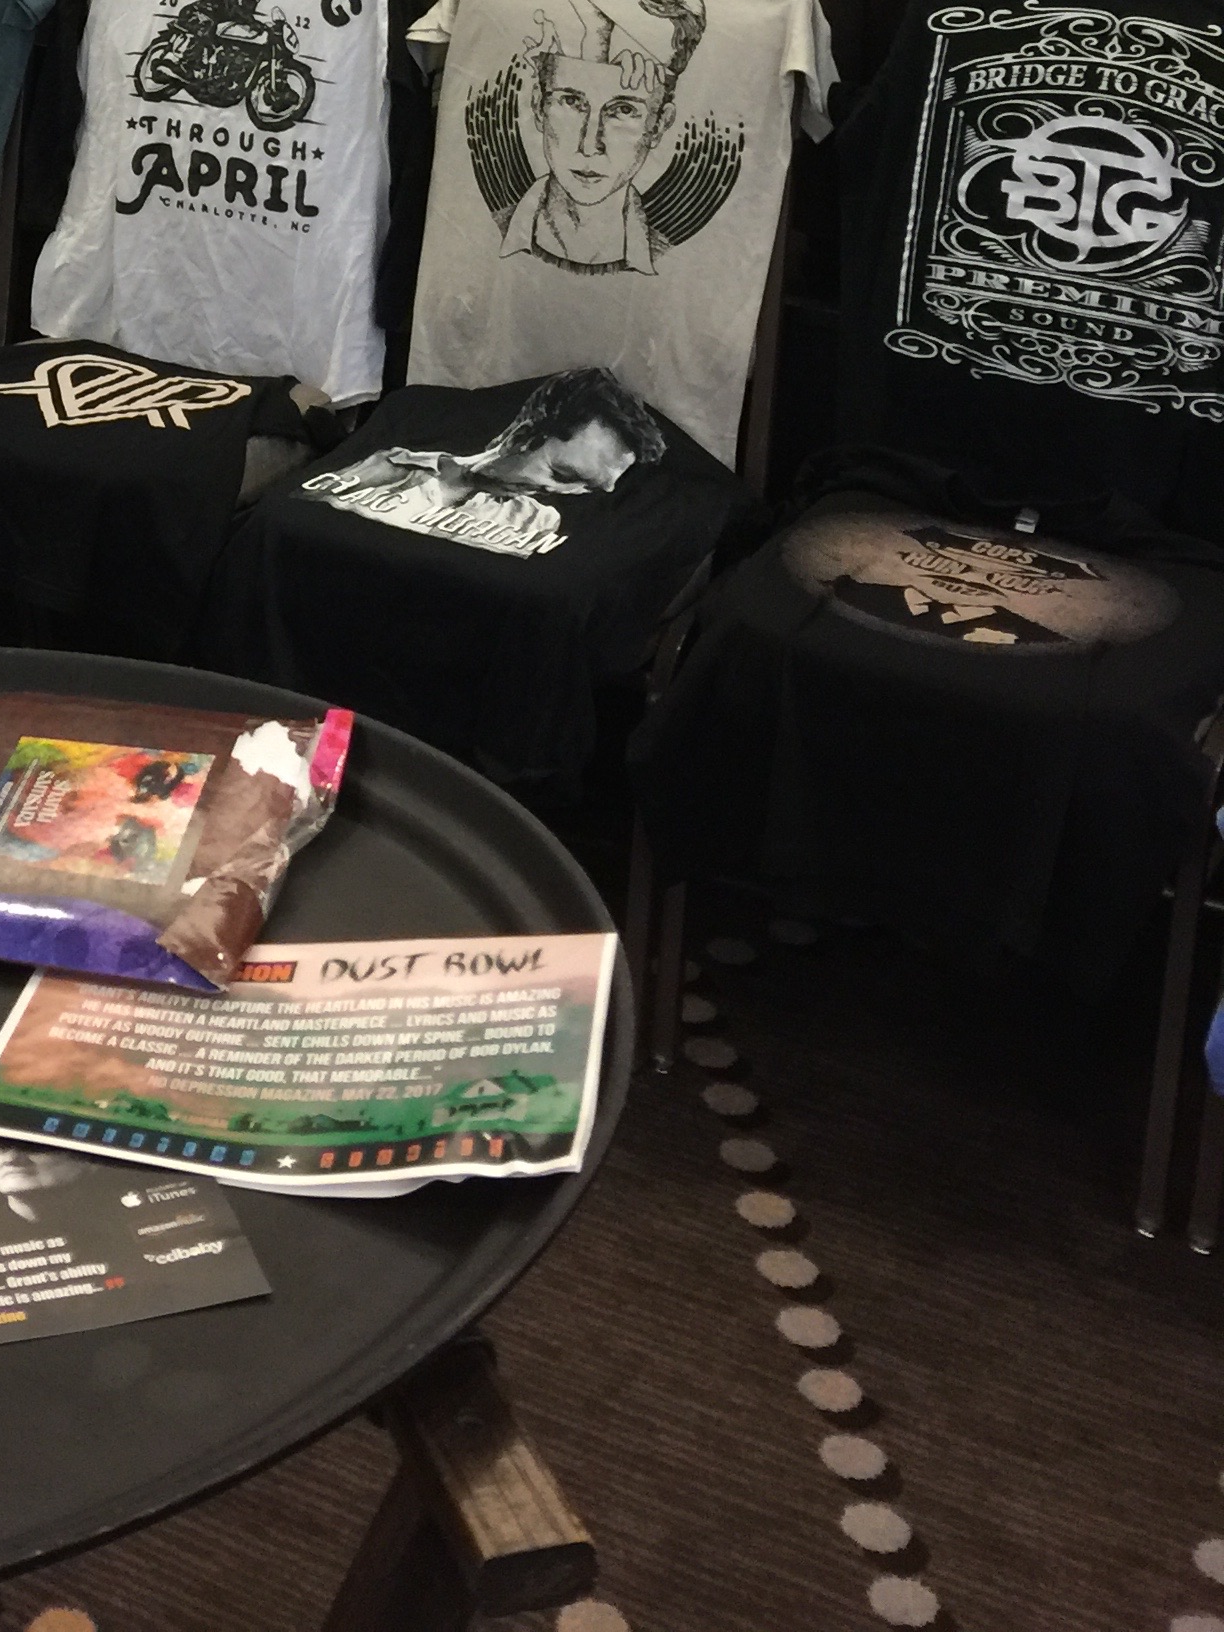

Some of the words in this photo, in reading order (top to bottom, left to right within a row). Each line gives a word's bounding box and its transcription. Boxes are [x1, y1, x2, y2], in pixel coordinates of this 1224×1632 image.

[295, 16, 310, 29] 12
[966, 64, 1087, 94] BRIDGE
[1096, 66, 1138, 94] TO
[1145, 78, 1224, 129] GRAC
[139, 116, 307, 161] THROUGH
[115, 142, 319, 218] APRIL
[291, 221, 311, 233] NC
[926, 264, 1224, 337] PREMIUM
[1009, 308, 1134, 342] SOUND
[301, 472, 408, 514] CRAIG
[410, 505, 568, 555] MORGAN
[971, 541, 1039, 564] COPS
[904, 551, 968, 575] RUIN
[989, 572, 1053, 594] YOUR
[321, 950, 436, 984] DUST
[443, 948, 547, 977] BOWL
[193, 998, 211, 1010] TO
[212, 999, 275, 1014] CAPTURE
[278, 1002, 303, 1014] THE
[305, 998, 386, 1014] HEARTLAND
[388, 997, 404, 1009] IN
[406, 996, 430, 1009] HIS
[479, 993, 493, 1005] IS
[496, 987, 561, 1003] AMAZING
[59, 1011, 112, 1028] POTENT
[112, 1020, 133, 1033] AS
[134, 1022, 185, 1039] WOODY
[185, 1029, 246, 1046] GUTHRIE
[263, 1035, 300, 1048] SENT
[301, 1034, 350, 1048] CHILLS
[352, 1034, 395, 1047] DOWN
[397, 1032, 421, 1045] MY
[423, 1029, 465, 1045] SPINE
[484, 1025, 534, 1040] BOUND
[537, 1023, 555, 1037] TO
[103, 1002, 132, 1016] HAS
[133, 1007, 194, 1024] WRITTEN
[208, 1015, 291, 1031] HEARTLAND
[292, 1015, 387, 1030] MASTERPIECE
[406, 1013, 455, 1027] LYRICS
[457, 1011, 488, 1024] AND
[490, 1006, 535, 1022] MUSIC
[537, 1005, 558, 1018] AS
[49, 1026, 106, 1045] BECOME
[119, 1037, 178, 1056] CLASSIC
[208, 1049, 282, 1065] REMINDER
[283, 1053, 303, 1066] OF
[306, 1052, 333, 1066] THE
[334, 1051, 393, 1065] DARKER
[395, 1049, 447, 1063] PERIOD
[448, 1046, 468, 1060] OF
[470, 1044, 501, 1058] BOB
[145, 1057, 177, 1073] AND
[177, 1061, 205, 1077] IT'S
[208, 1065, 244, 1080] THAT
[292, 1070, 328, 1083] THAT
[170, 1078, 259, 1099] DEPRESSION
[402, 1083, 444, 1098] 2017
[148, 1187, 197, 1203] iTunes
[0, 1240, 45, 1256] music
[6, 1271, 59, 1288] Grant's
[60, 1263, 107, 1280] ability
[8, 1256, 47, 1271] down
